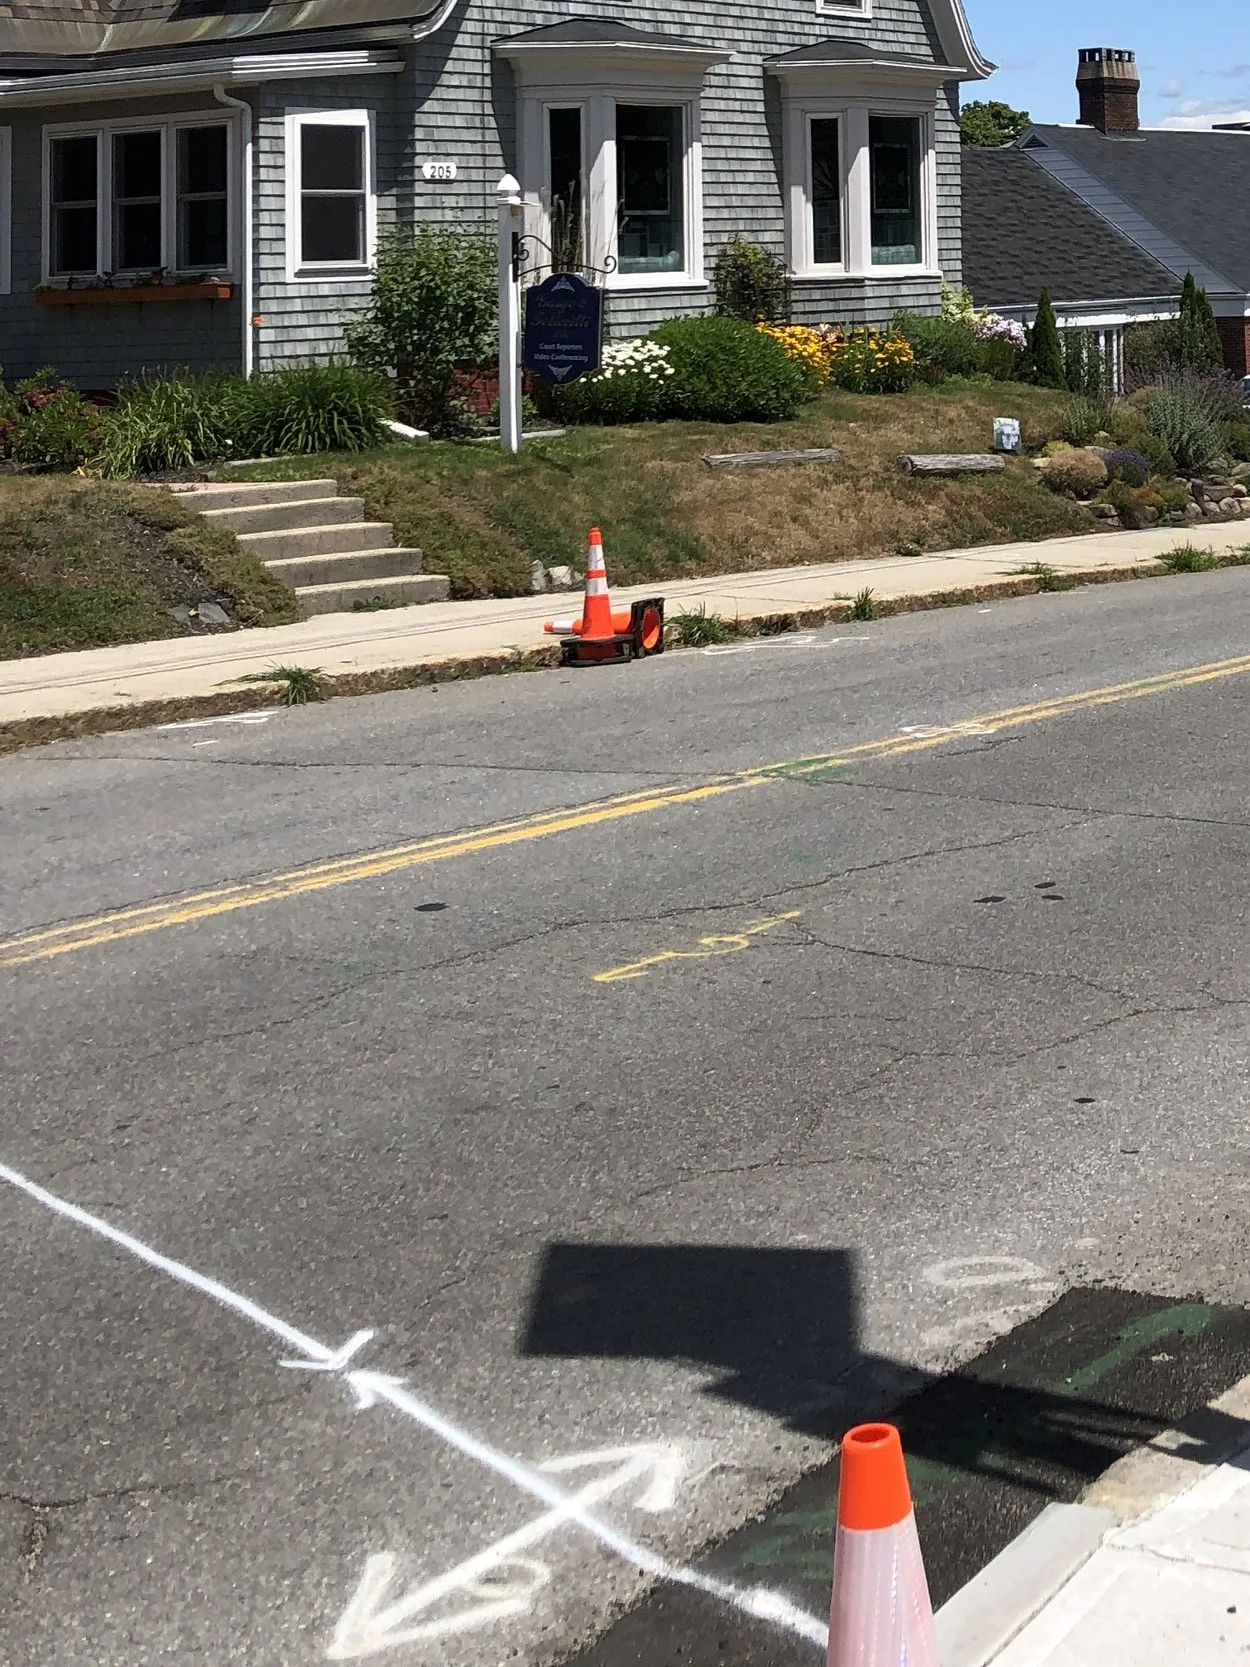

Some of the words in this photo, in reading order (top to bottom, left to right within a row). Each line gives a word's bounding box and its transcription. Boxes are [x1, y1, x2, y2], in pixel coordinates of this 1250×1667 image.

[430, 165, 451, 179] 205
[557, 343, 583, 351] Reporters
[551, 354, 588, 363] Conferencing
